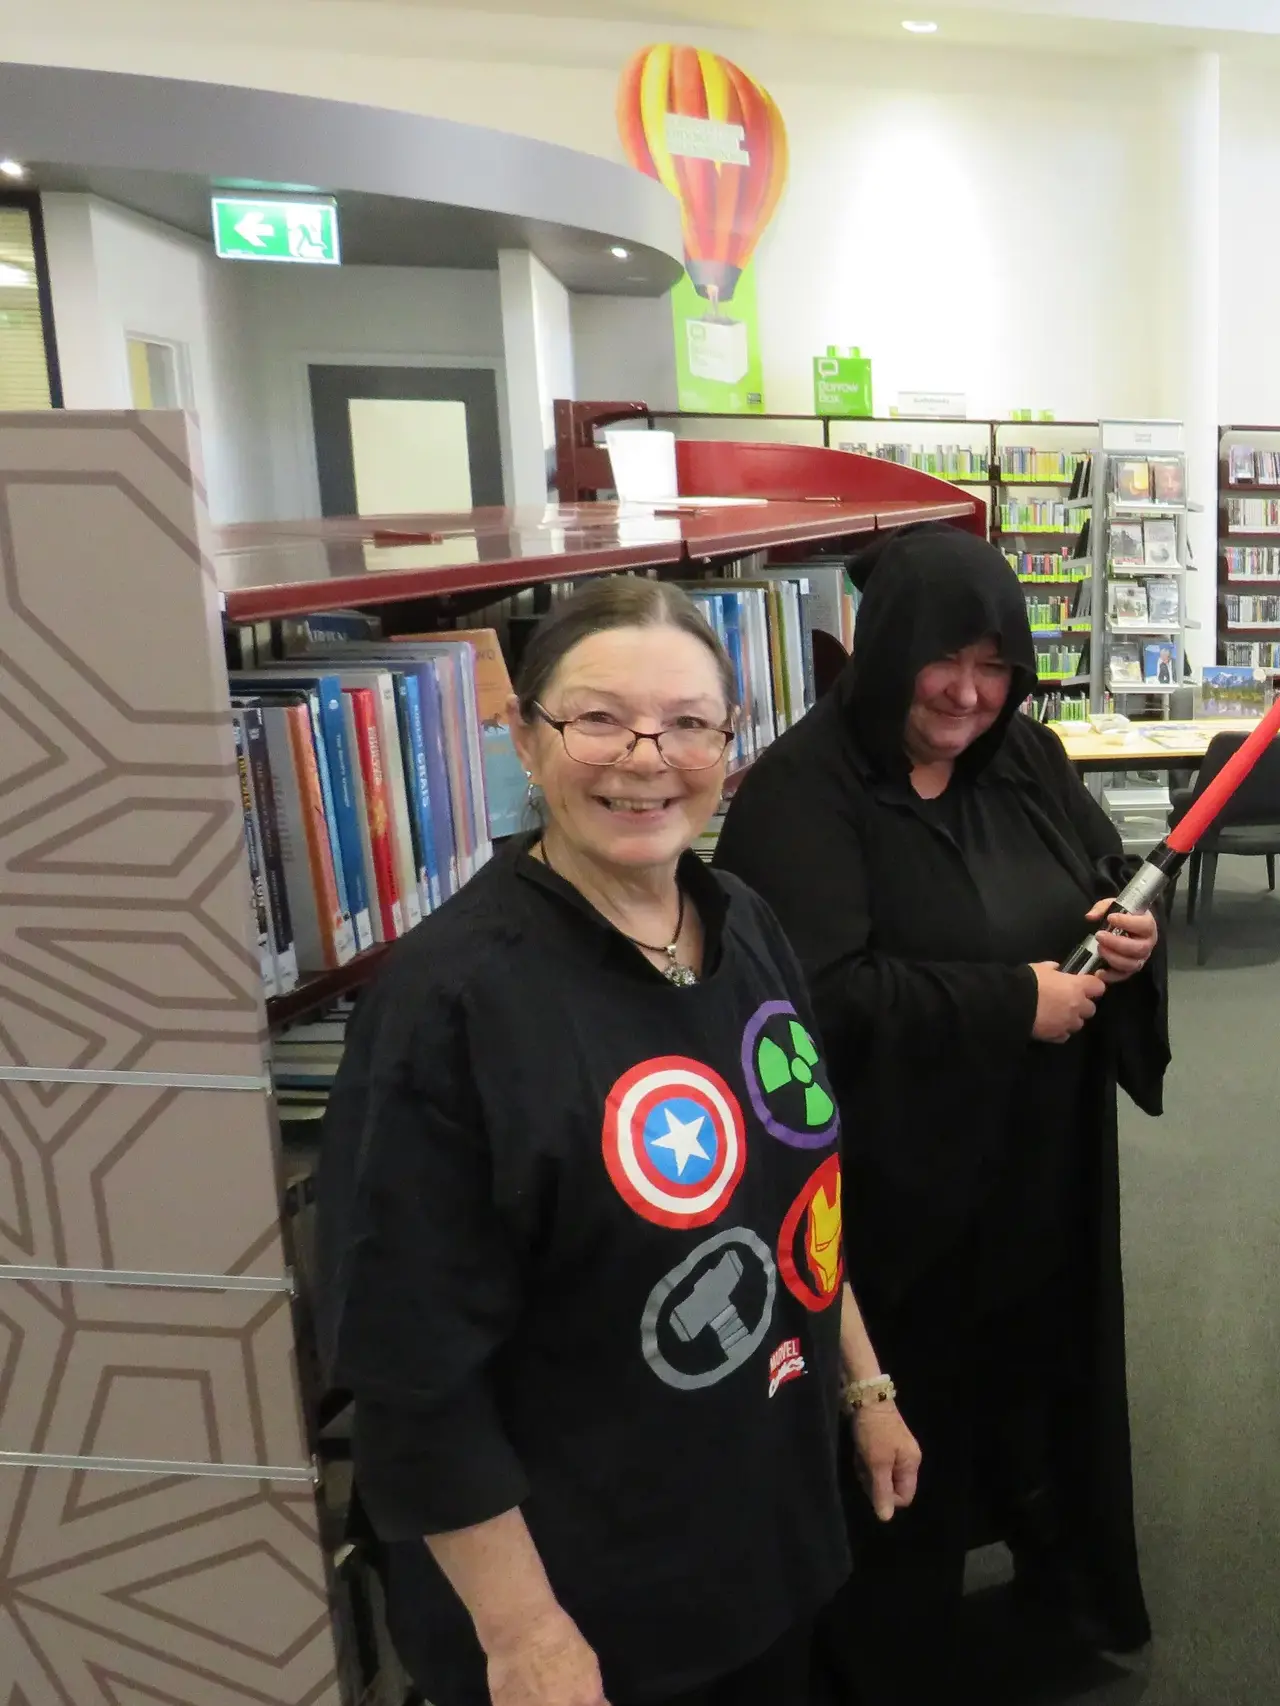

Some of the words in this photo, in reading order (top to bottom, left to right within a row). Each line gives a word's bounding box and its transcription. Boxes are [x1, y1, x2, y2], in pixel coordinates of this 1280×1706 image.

[818, 380, 859, 393] Borrow
[416, 751, 430, 807] CRAIS
[769, 1339, 800, 1373] MARVEL
